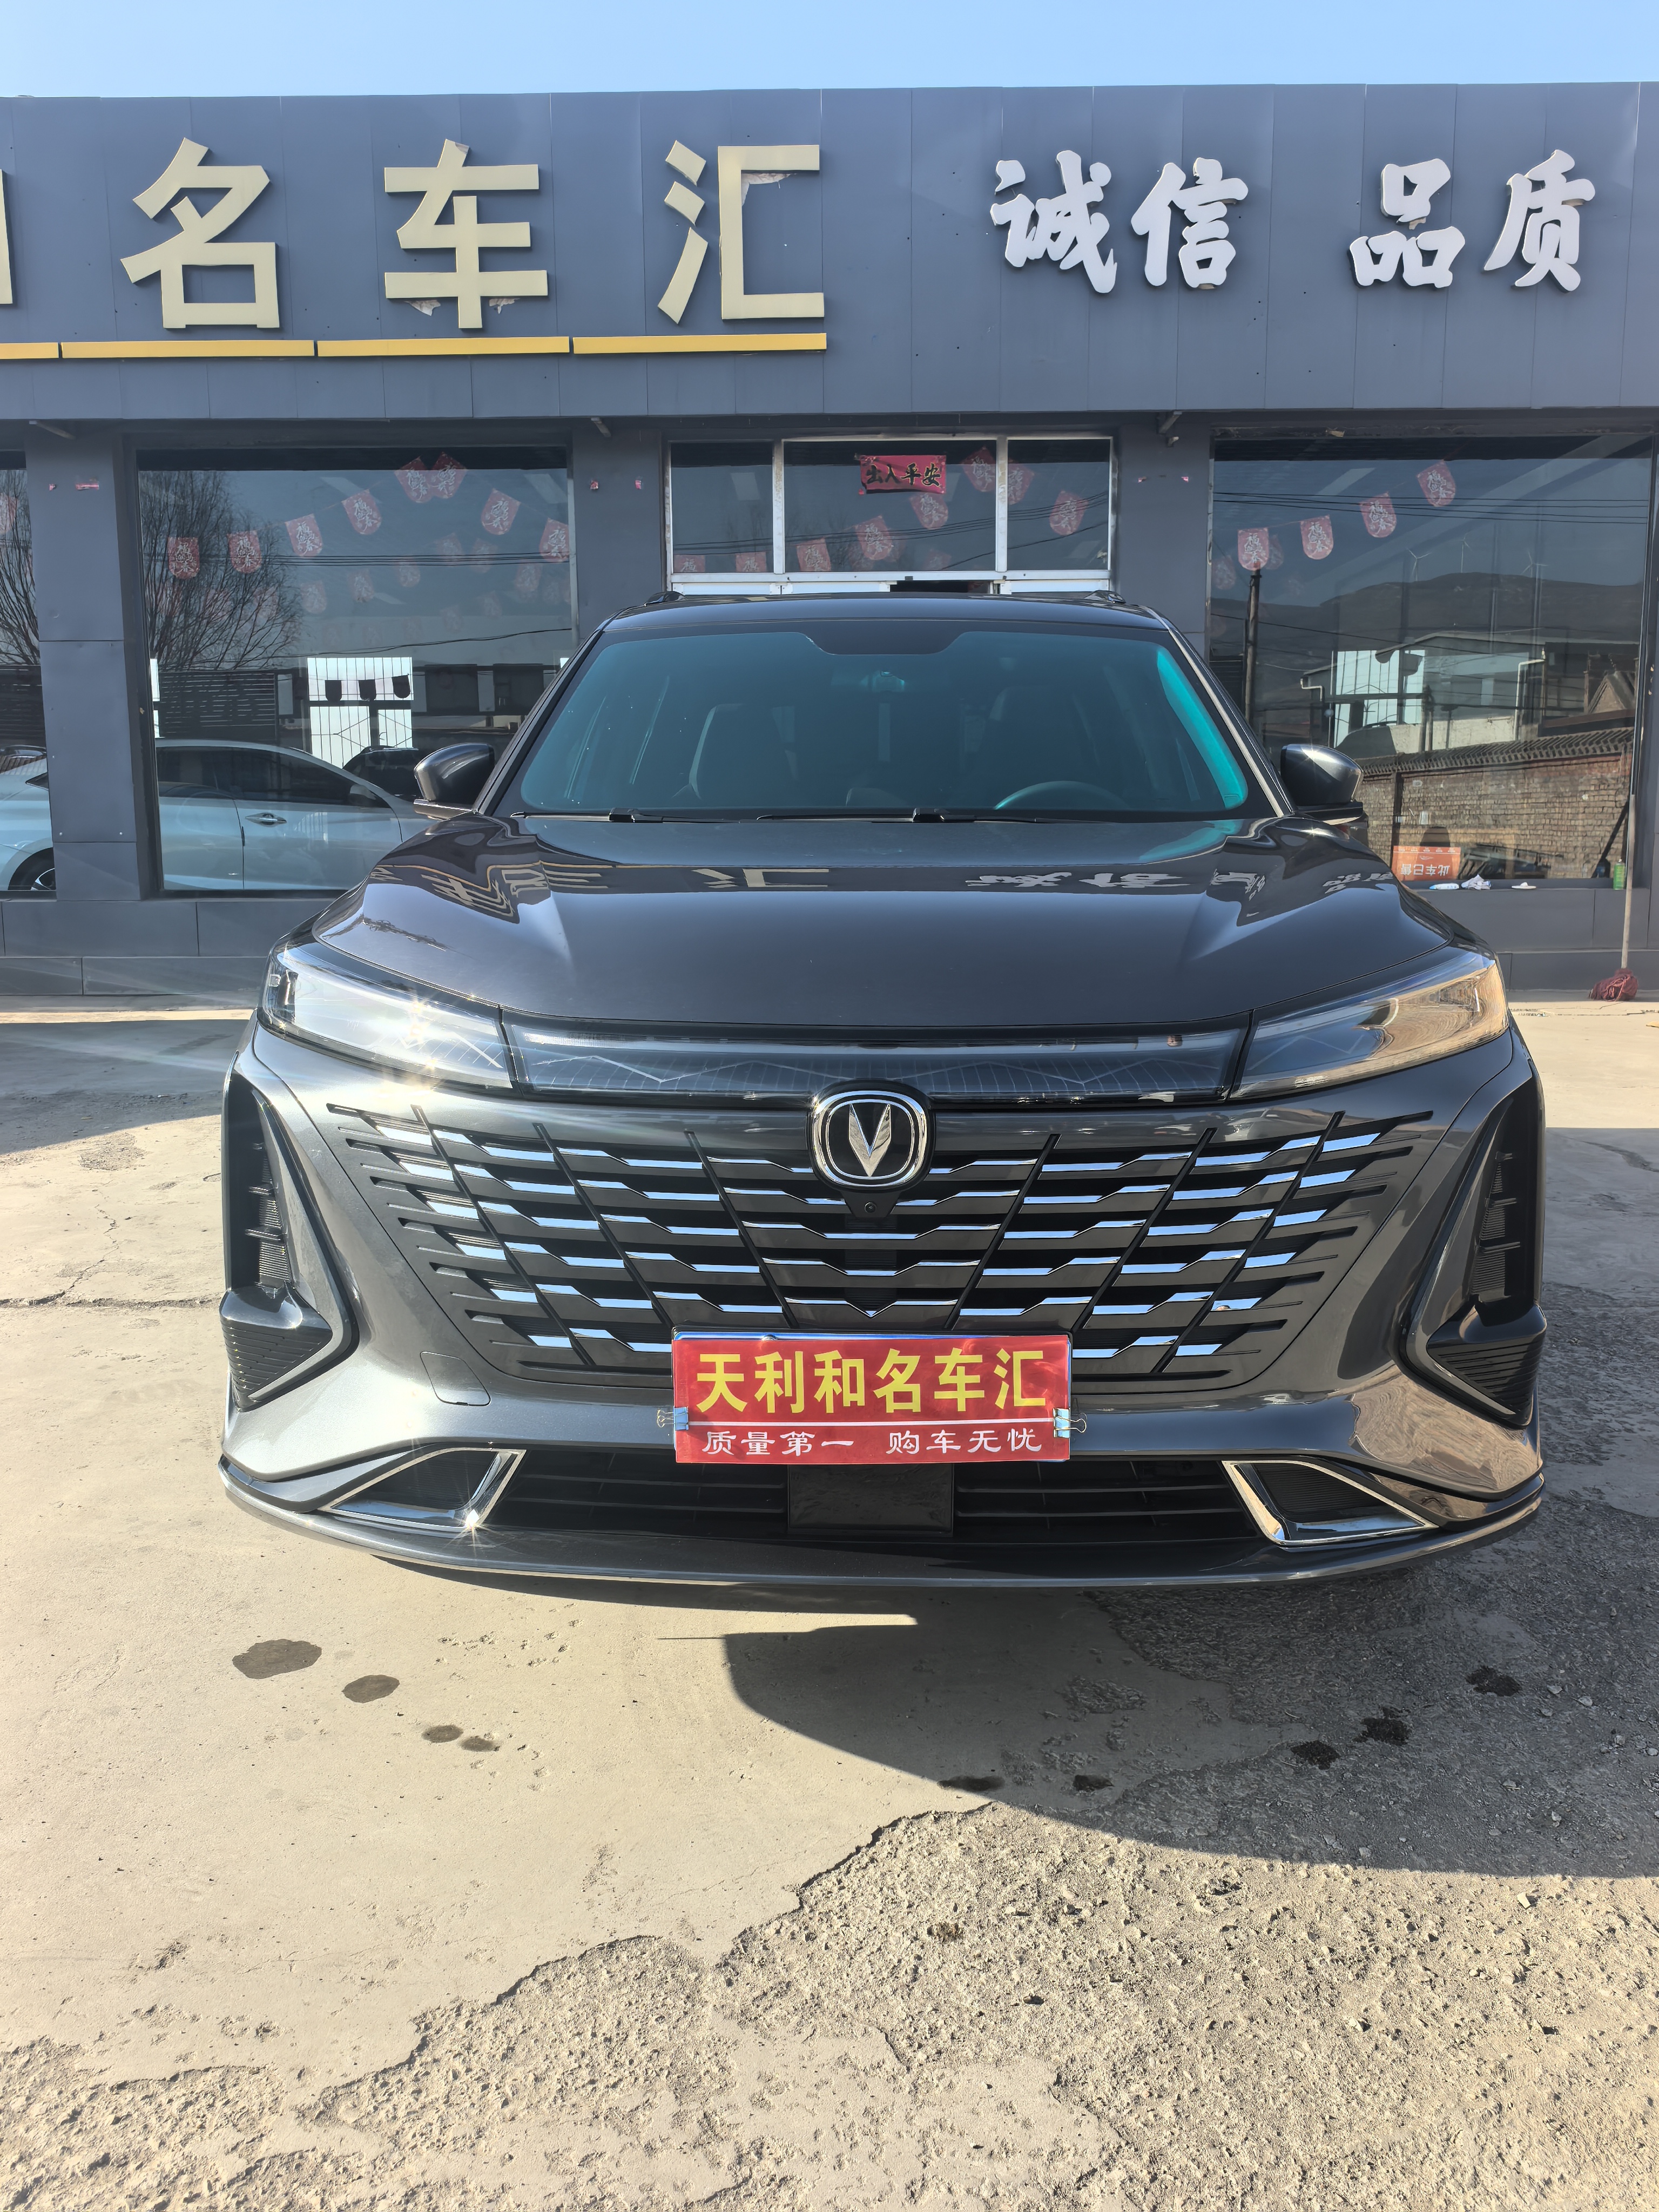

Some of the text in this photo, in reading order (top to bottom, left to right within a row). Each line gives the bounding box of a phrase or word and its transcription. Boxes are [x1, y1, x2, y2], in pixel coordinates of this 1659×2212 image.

[0, 137, 825, 329] 名车汇
[989, 150, 1596, 294] 诚信 品质
[866, 462, 942, 487] 出入平安
[1400, 864, 1451, 876] 此车已售
[696, 1348, 1047, 1414] 天利和名车汇
[702, 1428, 1042, 1456] 质量第一 购车无忧
